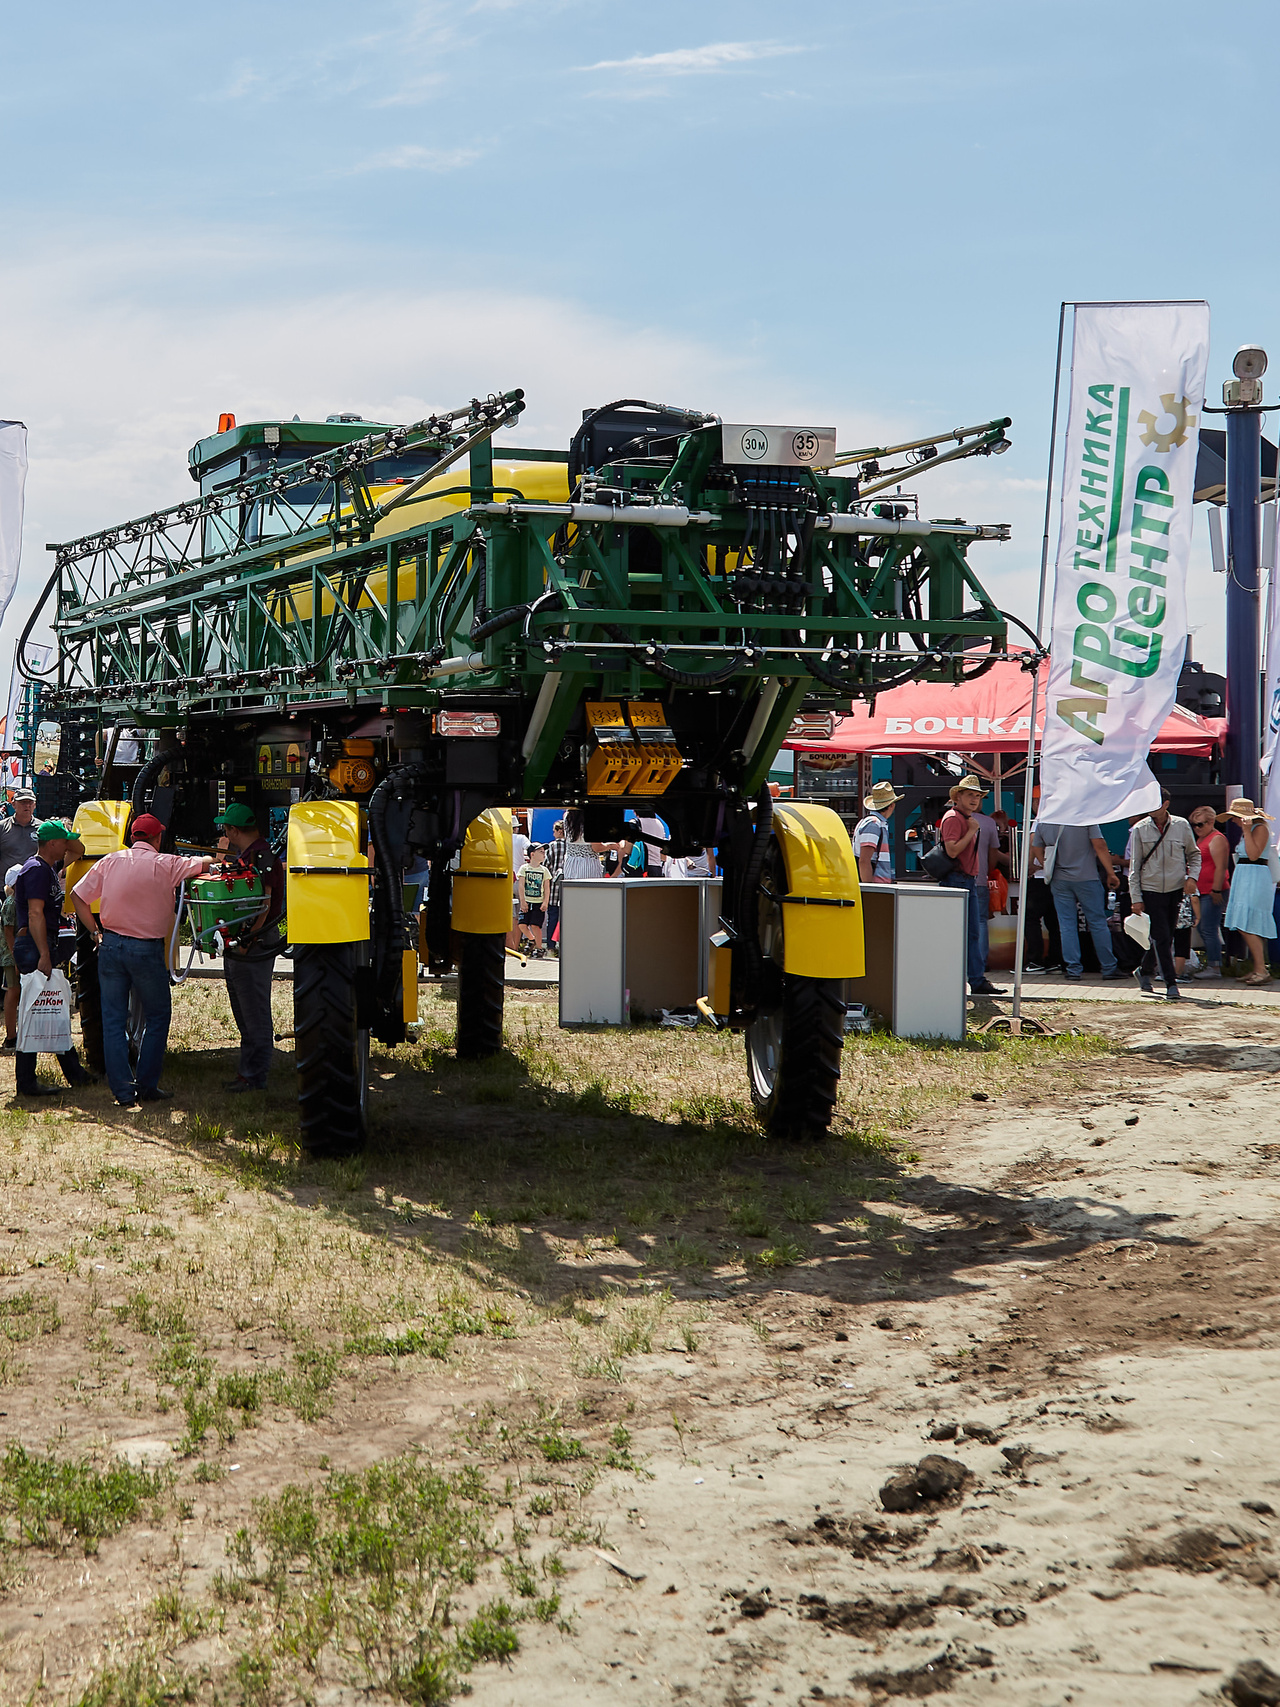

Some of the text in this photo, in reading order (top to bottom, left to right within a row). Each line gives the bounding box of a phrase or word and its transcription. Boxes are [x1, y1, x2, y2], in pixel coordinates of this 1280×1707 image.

[745, 438, 757, 450] 30
[796, 435, 814, 450] 35
[1056, 382, 1118, 746] АГРО ТЕХНИКА
[884, 716, 1046, 735] БОЧКА
[39, 990, 61, 998] ЛДИНГ
[32, 998, 63, 1006] елКом
